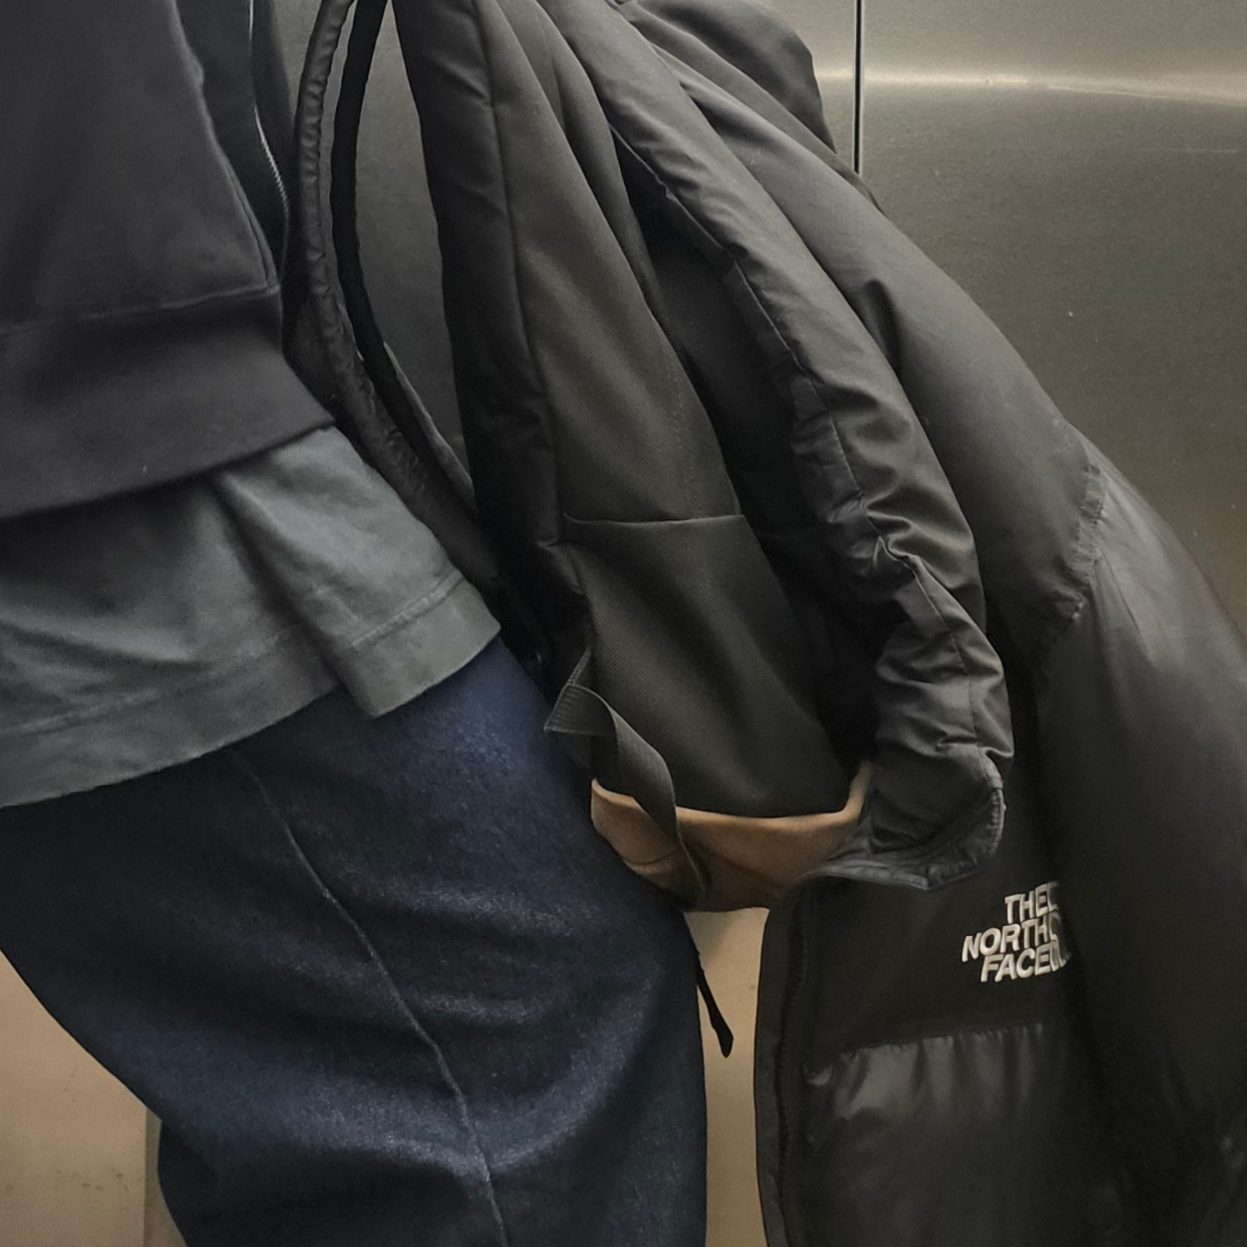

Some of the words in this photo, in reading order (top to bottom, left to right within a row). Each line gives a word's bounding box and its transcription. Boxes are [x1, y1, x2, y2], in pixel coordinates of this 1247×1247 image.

[1005, 884, 1049, 924] THE
[962, 915, 1049, 962] NORTH
[981, 943, 1051, 982] FACE
